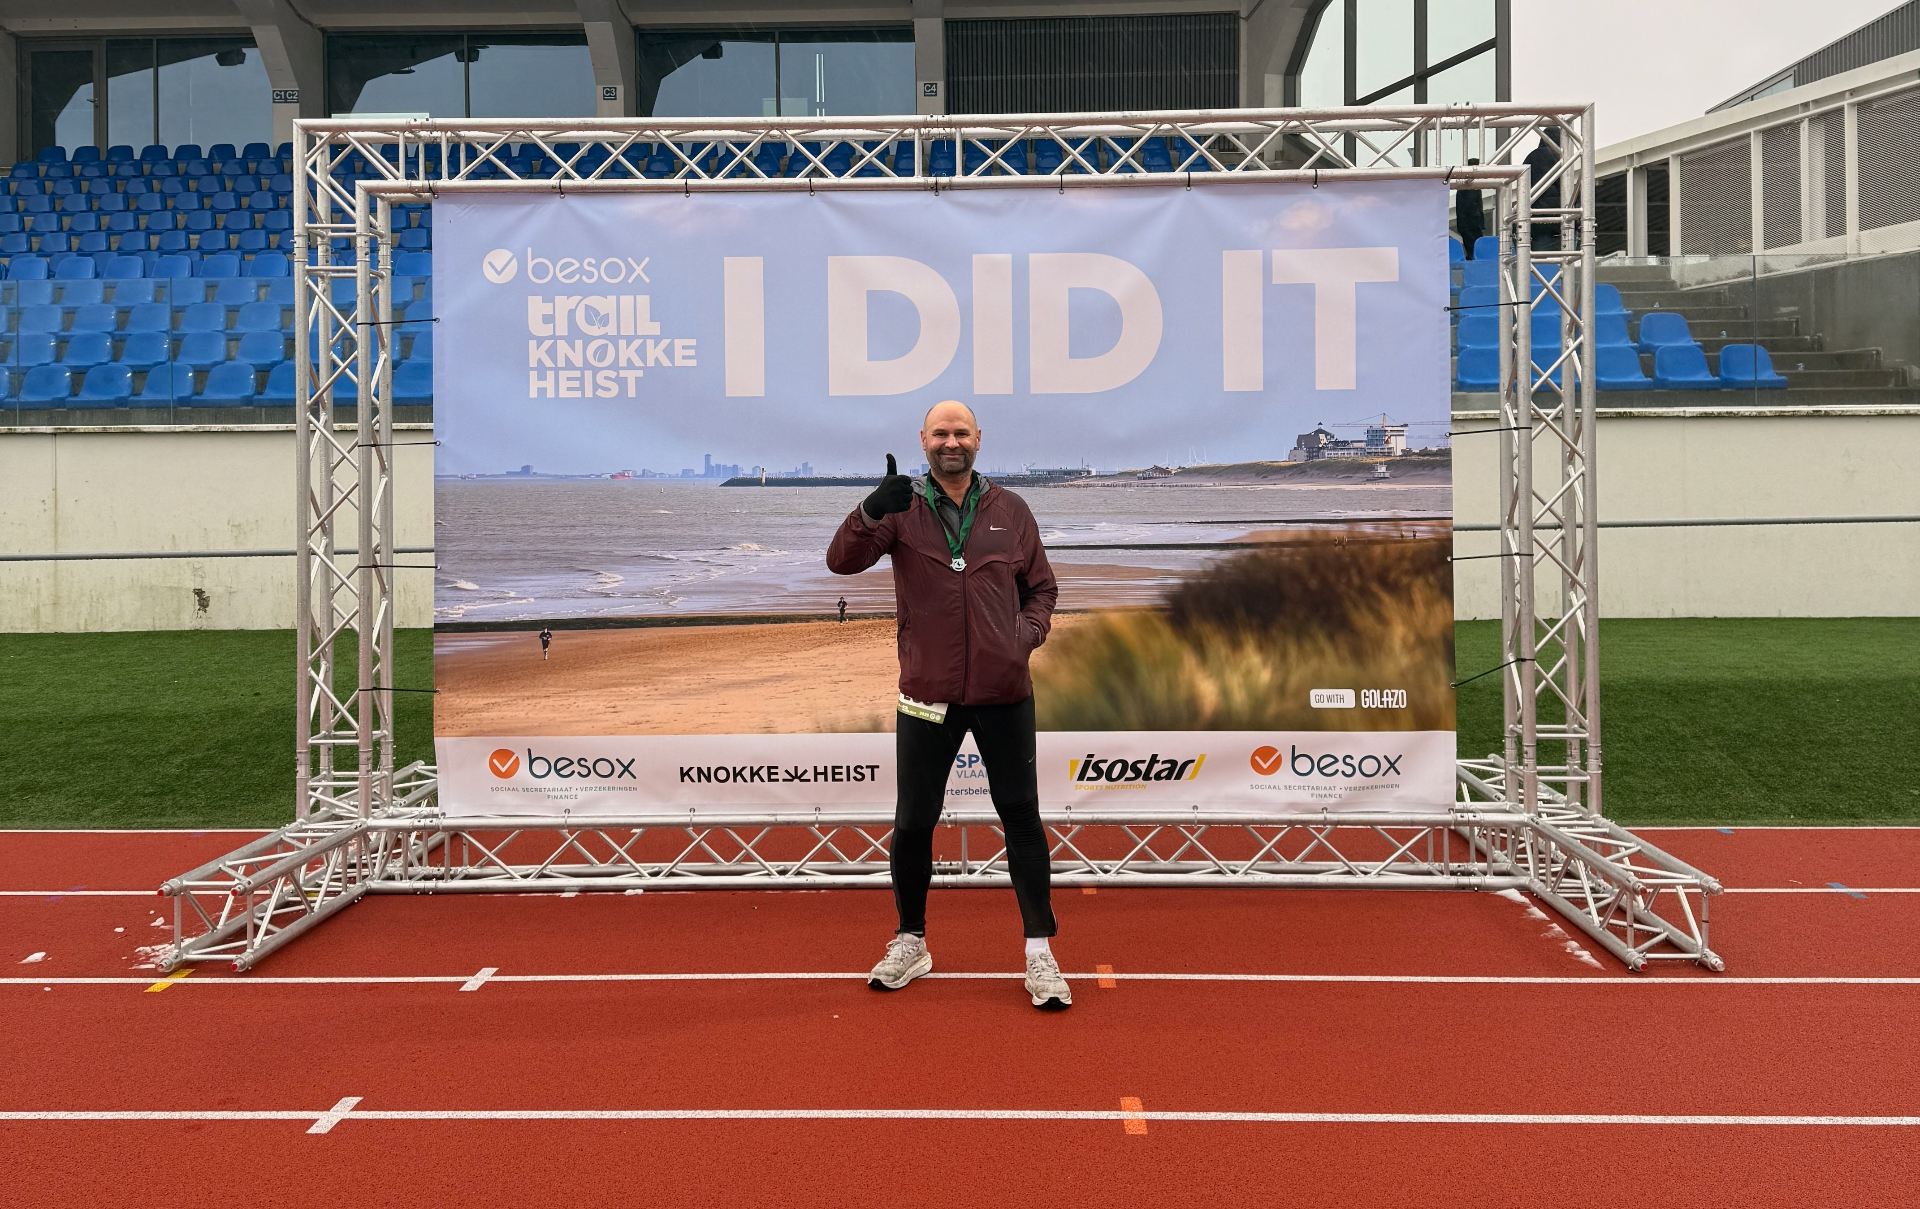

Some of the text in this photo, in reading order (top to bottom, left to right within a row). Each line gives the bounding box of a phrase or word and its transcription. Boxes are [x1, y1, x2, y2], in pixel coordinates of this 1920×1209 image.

[273, 91, 298, 99] C1 C2
[603, 88, 616, 96] C3
[924, 84, 937, 92] C4
[527, 247, 650, 284] besox
[724, 247, 1399, 397] I DID IT
[528, 338, 697, 368] KNOKKE
[529, 369, 644, 398] HEIST
[1314, 689, 1407, 709] GO WITH GOLAZO
[527, 748, 637, 780] besox
[1076, 753, 1196, 782] isostar
[1291, 744, 1403, 778] besox
[679, 764, 880, 783] KNOKKE HEIST
[521, 786, 573, 794] SECRETARIAAT
[579, 785, 638, 793] VERZEKERINGEN
[1104, 783, 1147, 791] NUTRITION
[1283, 784, 1337, 792] SECRETARIAAT
[1343, 783, 1400, 792] VERZEKERINGEN
